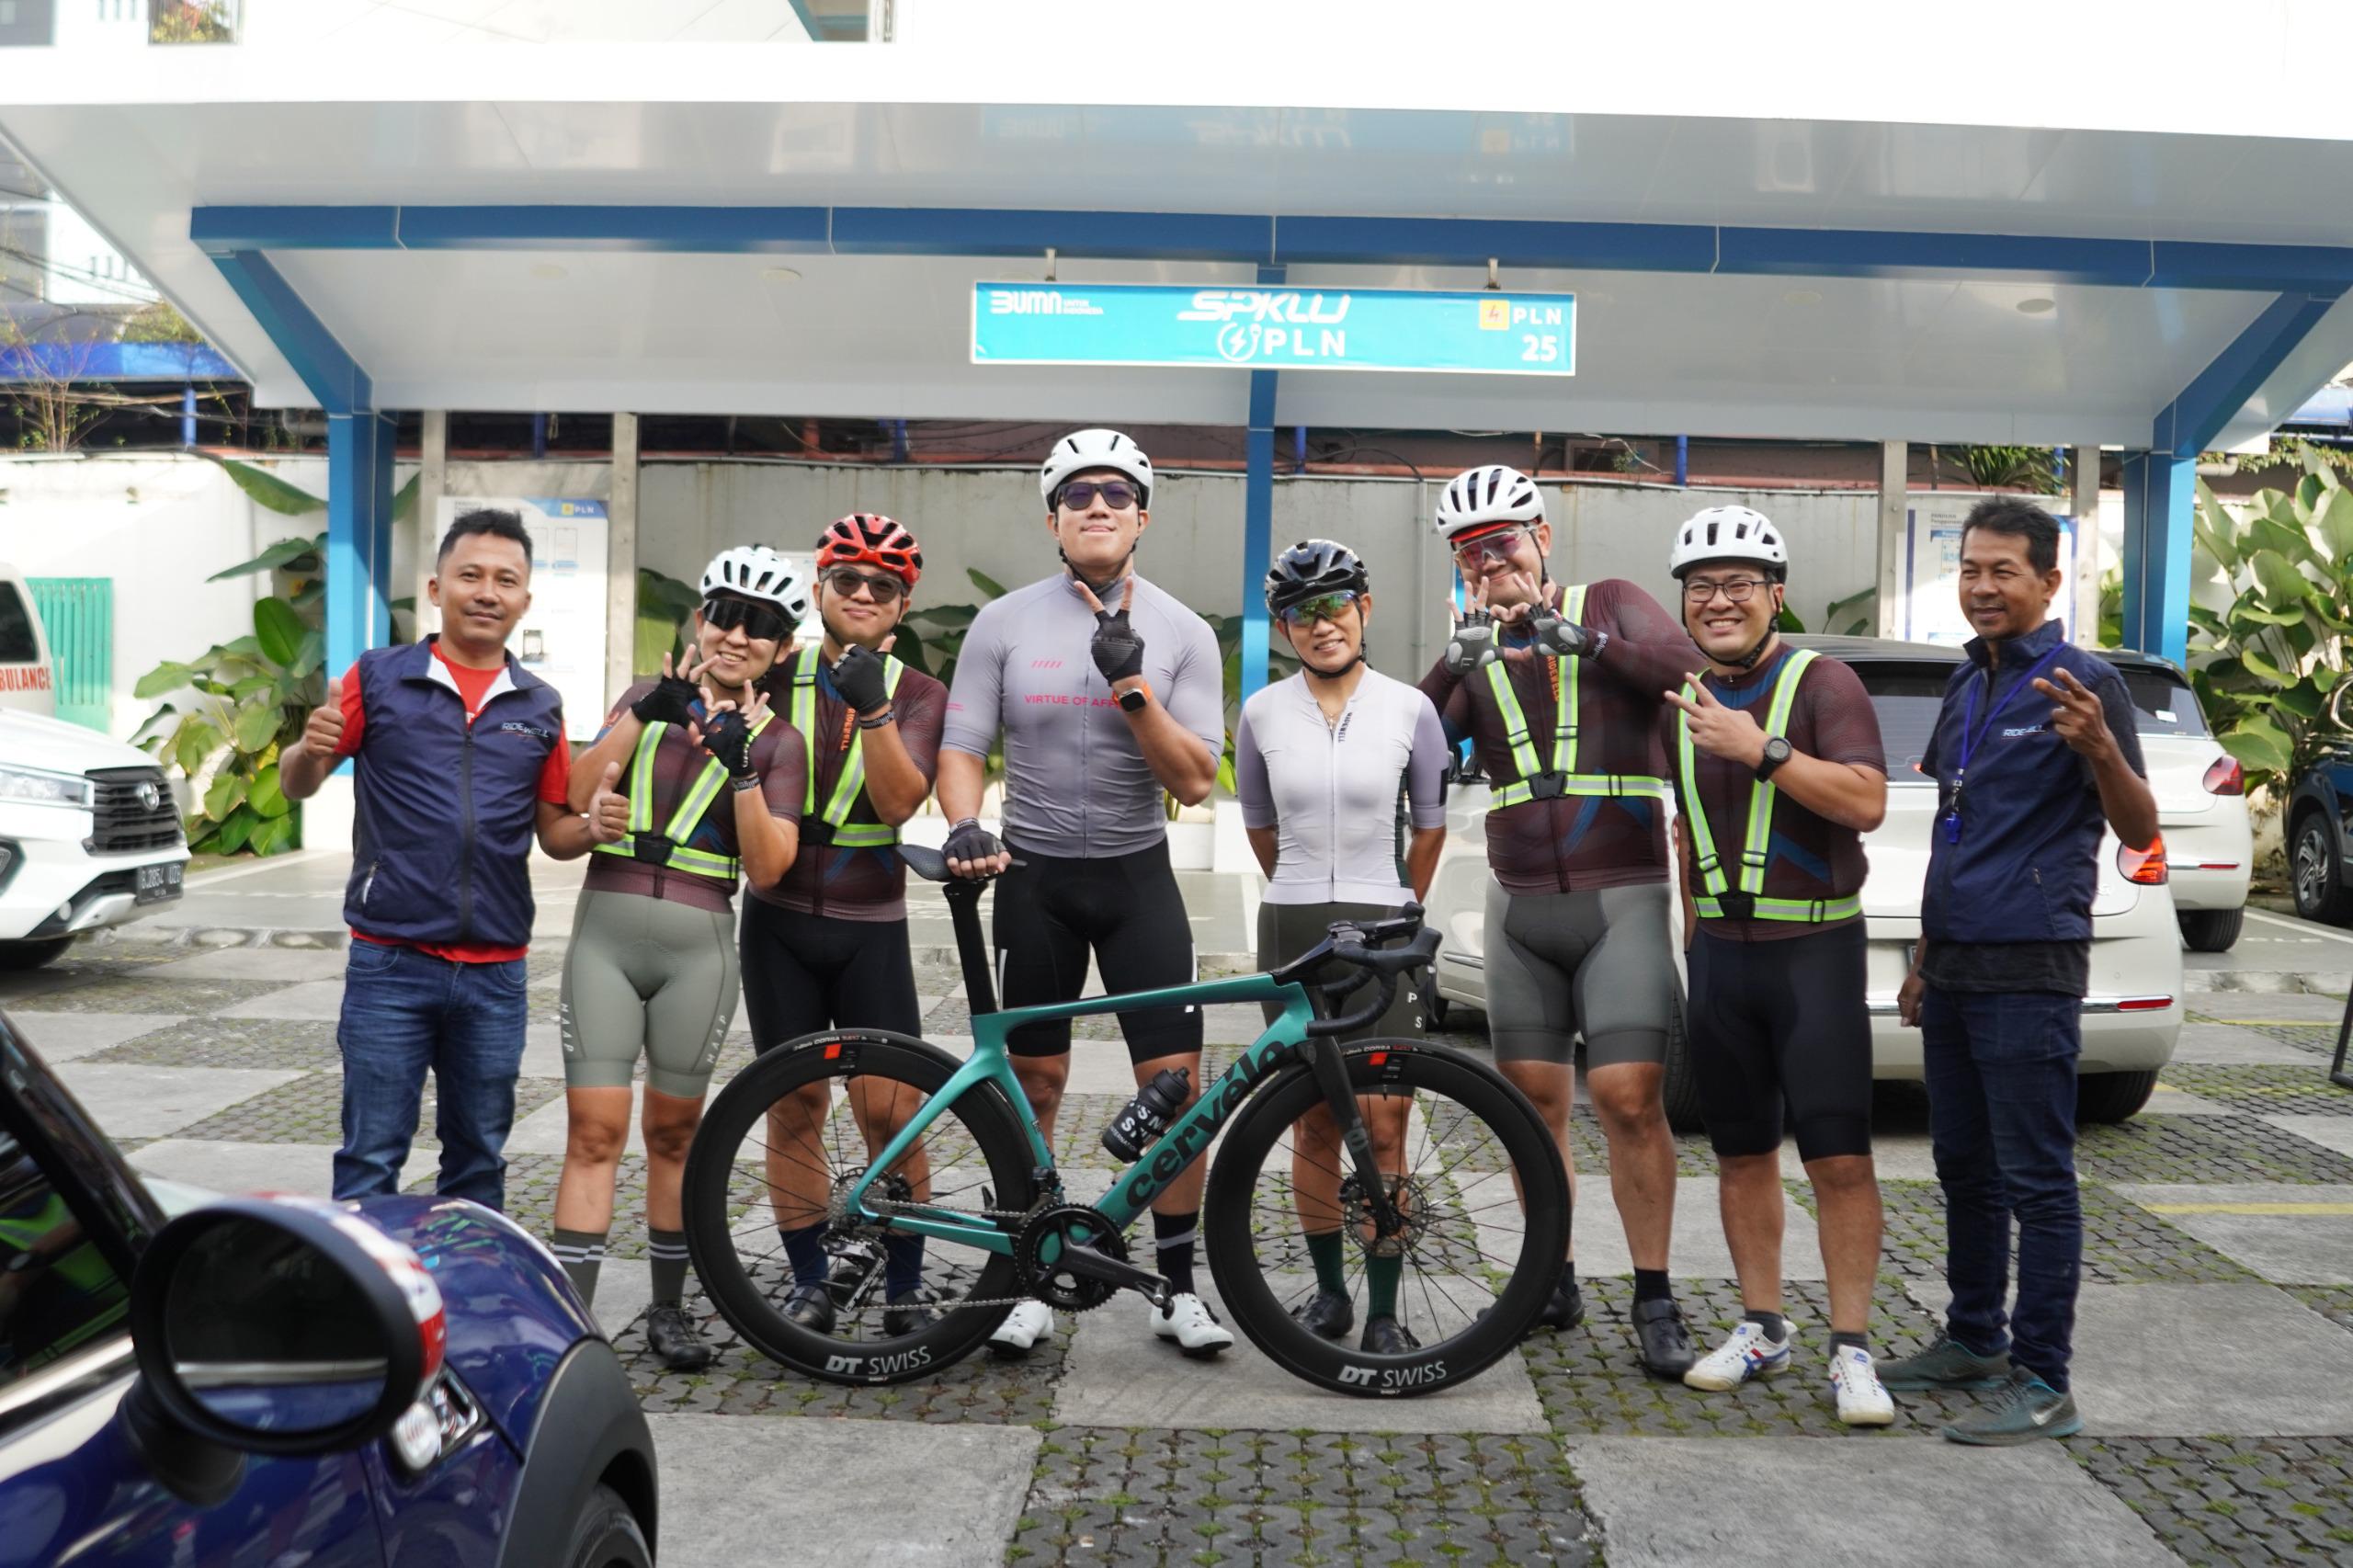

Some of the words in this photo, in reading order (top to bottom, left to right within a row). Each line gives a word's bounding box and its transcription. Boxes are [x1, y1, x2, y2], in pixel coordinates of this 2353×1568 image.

[1513, 307, 1562, 324] PLN
[1264, 327, 1346, 357] PLN
[1521, 333, 1558, 362] 25
[1024, 694, 1070, 705] VIRTUE
[1073, 697, 1089, 706] OF
[825, 1355, 863, 1375] DT
[868, 1346, 932, 1376] SWISS
[1337, 1365, 1378, 1386] DT
[1381, 1360, 1448, 1388] SWISS
